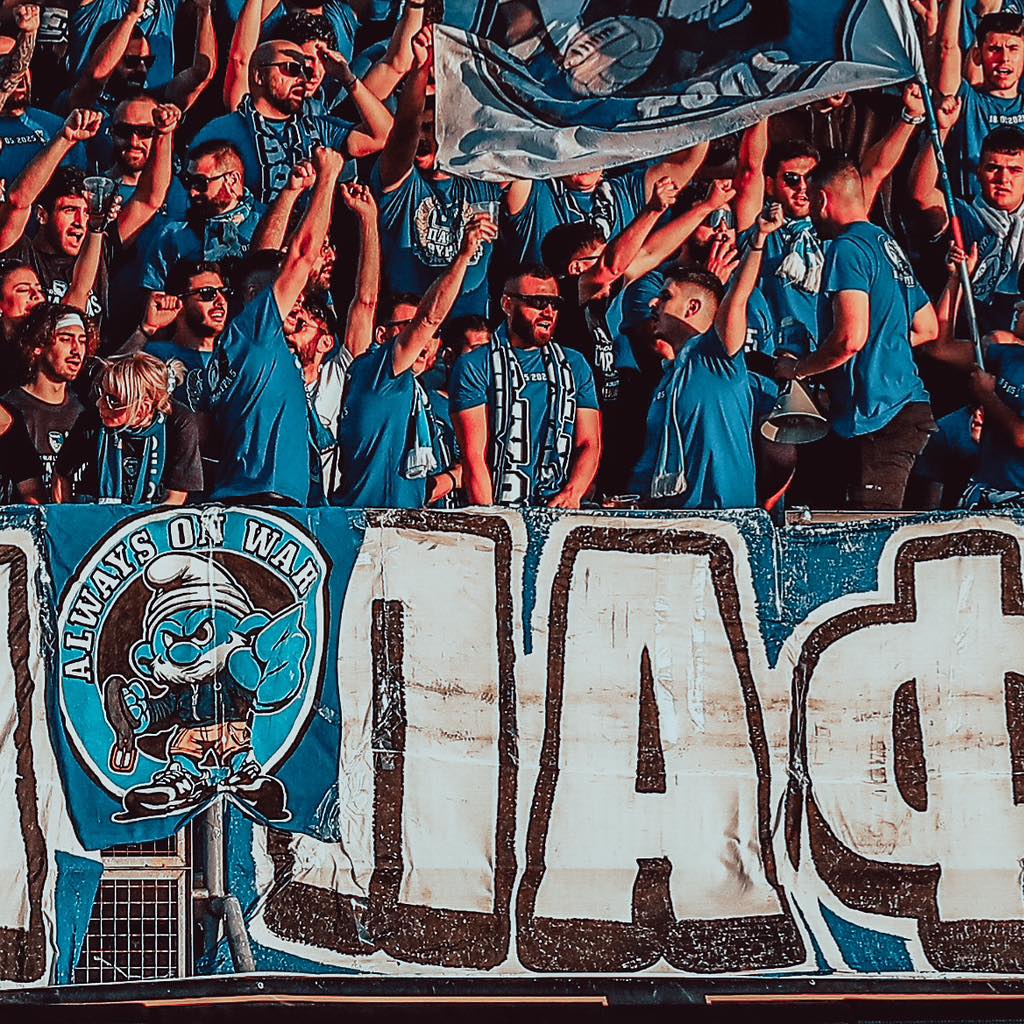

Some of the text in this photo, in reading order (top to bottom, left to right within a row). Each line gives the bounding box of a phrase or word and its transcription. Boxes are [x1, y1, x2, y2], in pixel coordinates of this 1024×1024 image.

[531, 373, 548, 381] 202
[62, 511, 322, 681] ALWAYS ON WAR
